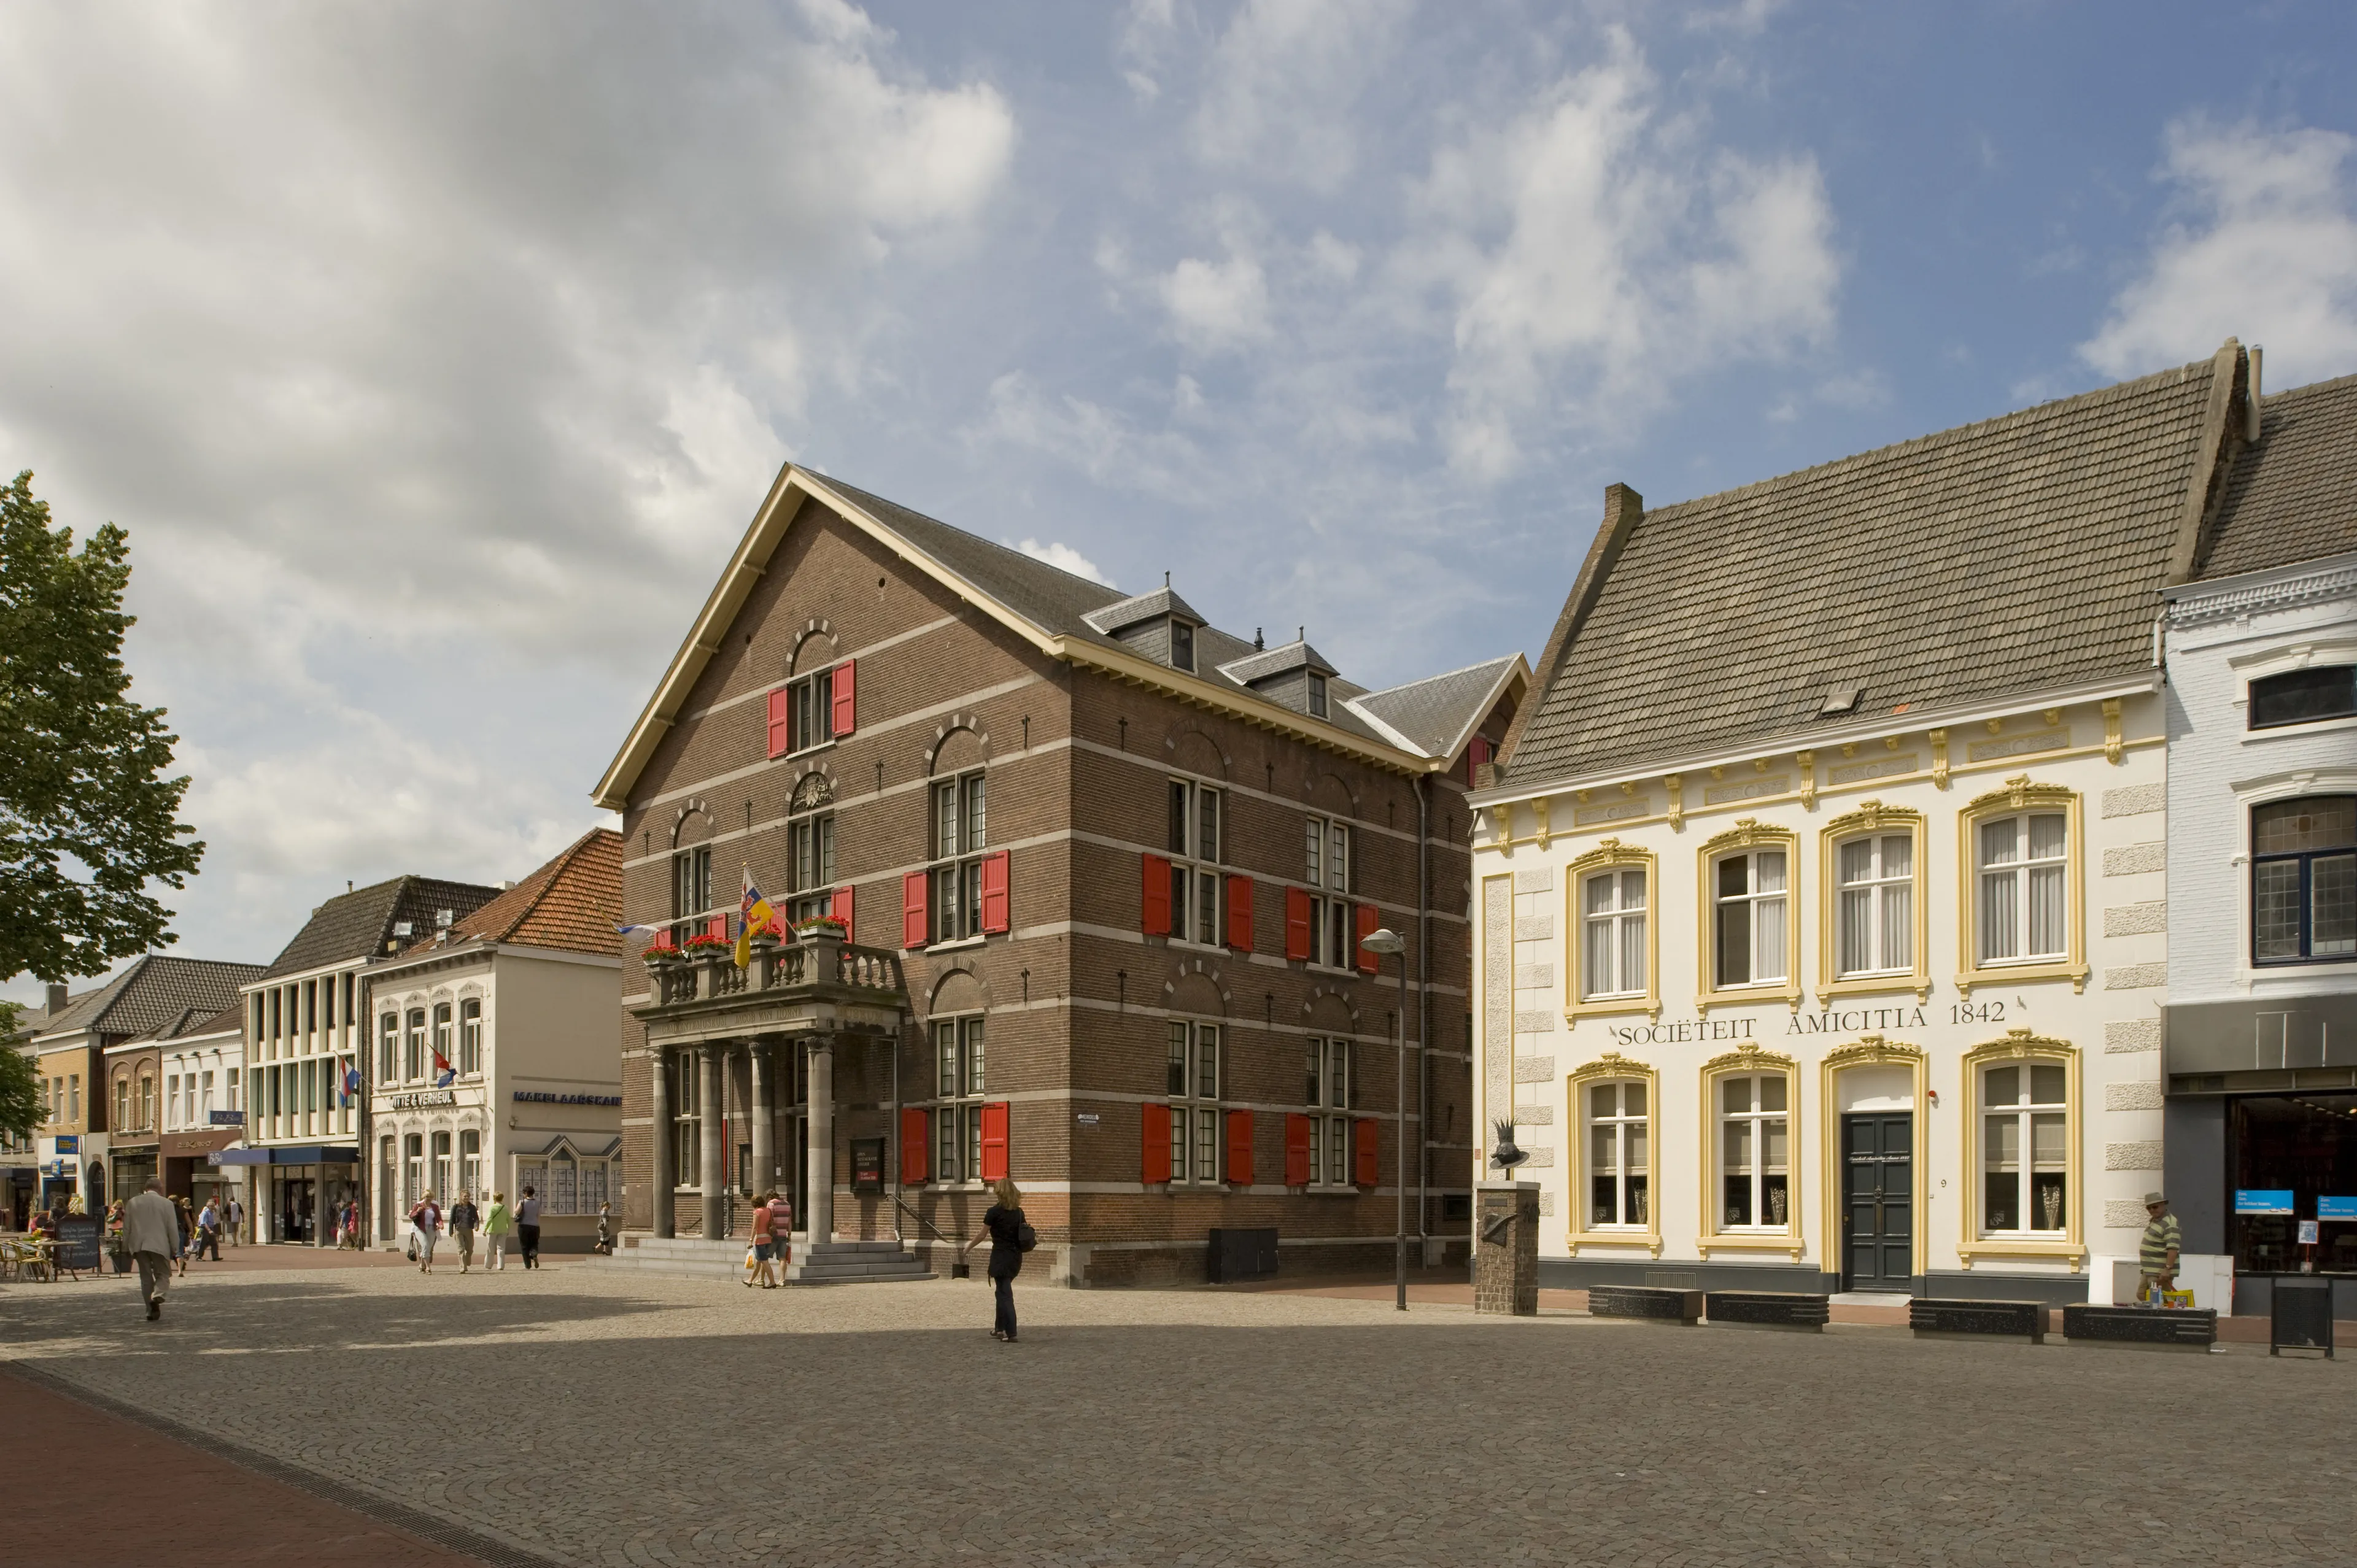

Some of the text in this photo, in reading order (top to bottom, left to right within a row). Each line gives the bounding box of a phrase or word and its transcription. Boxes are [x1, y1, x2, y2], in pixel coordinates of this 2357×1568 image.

[660, 1016, 727, 1034] GEMEENTEMUSEUM
[735, 1011, 755, 1024] JACOB
[759, 1010, 772, 1021] VAN
[1619, 1002, 2005, 1046] SOCIËTEIT AMICITIA 1842
[388, 1091, 452, 1107] WITTE & VERHEUL
[1941, 1179, 1946, 1188] 9
